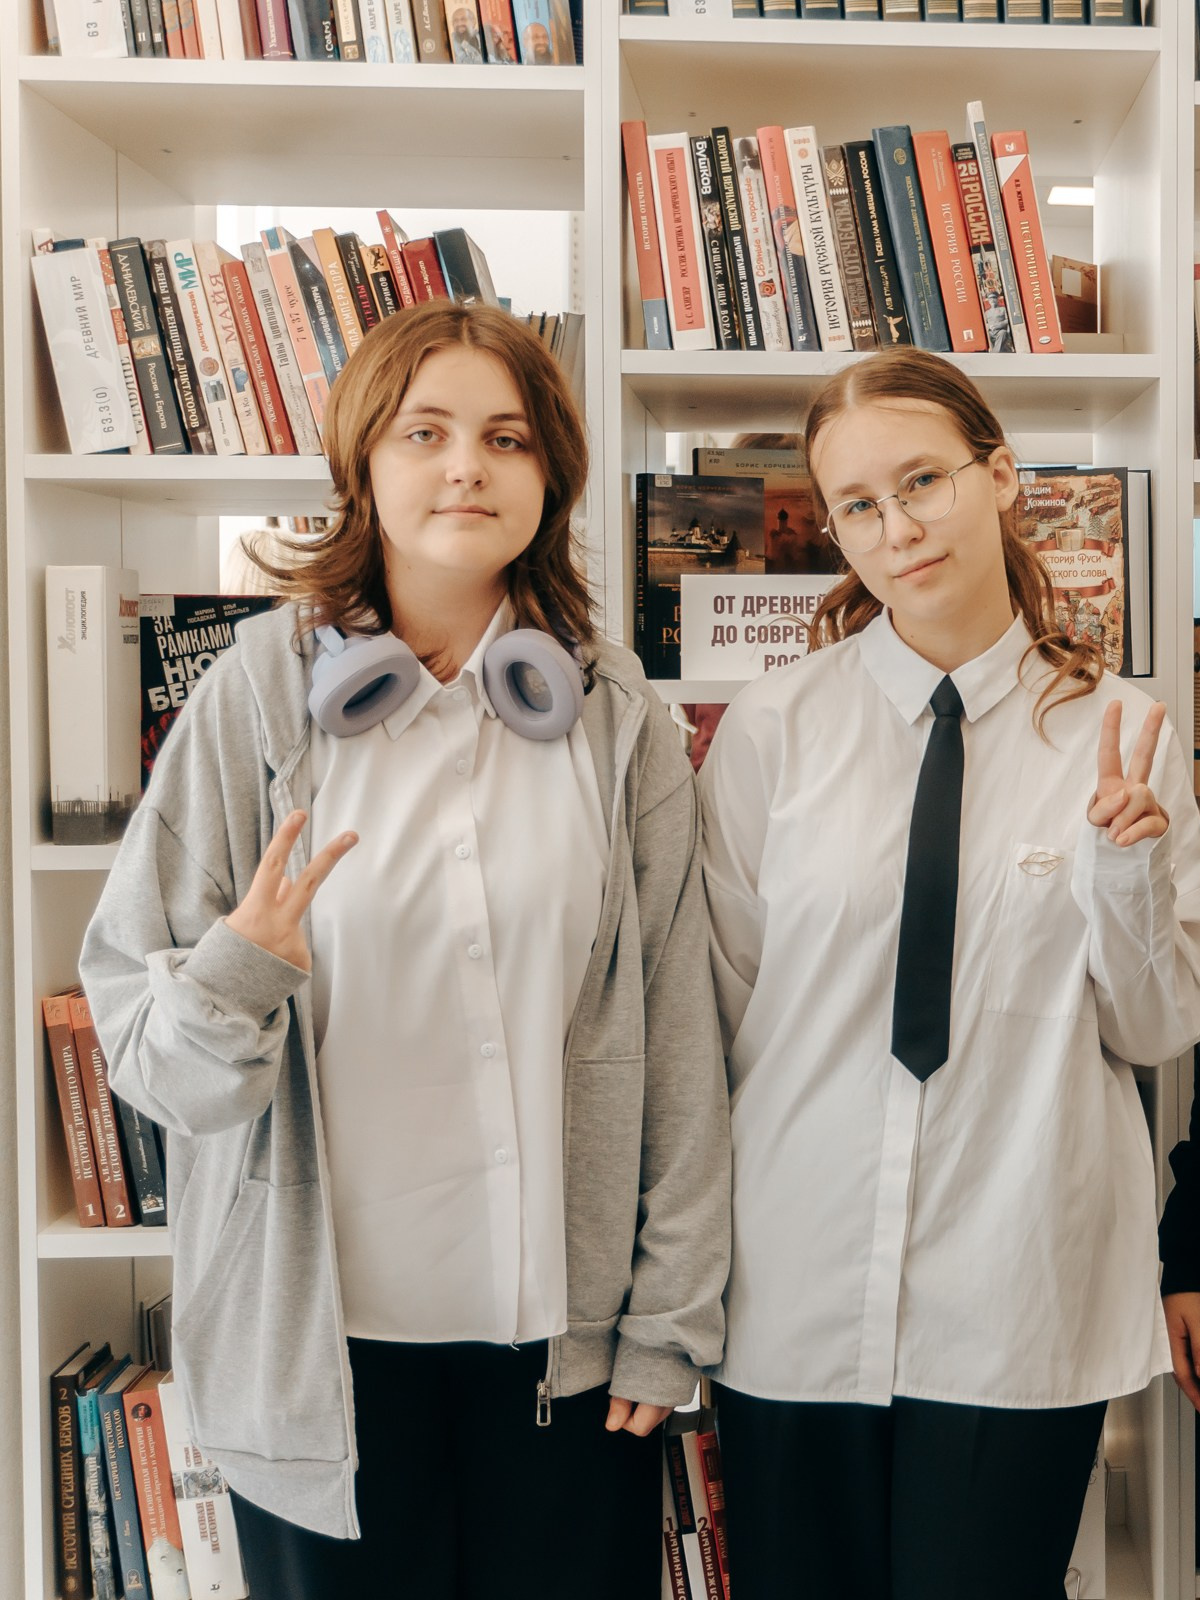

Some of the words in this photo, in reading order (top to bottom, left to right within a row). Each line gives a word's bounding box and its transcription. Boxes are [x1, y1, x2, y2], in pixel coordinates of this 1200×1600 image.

[696, 141, 712, 195] БУШКОВ
[717, 134, 731, 174] ГЕОРГИЙ
[859, 151, 870, 179] РОССИЯ
[957, 161, 978, 176] 26
[636, 172, 647, 220] ОТЕЧЕСТВА
[723, 175, 741, 231] ВЕРНАДСКИЙ
[801, 163, 823, 223] КУЛЬТУРЫ
[864, 181, 877, 219] ЗАВЕЩАНА
[811, 226, 833, 275] РУССКОЙ
[835, 198, 860, 275] ОТЕЧЕСТВА
[941, 202, 959, 254] ИСТОРИЯ
[951, 258, 968, 304] РОССИИ
[173, 252, 199, 290] МИР
[390, 250, 403, 273] ВЕЩЕЙ
[733, 236, 747, 279] НАЧЕРТАНИЕ
[1019, 220, 1039, 278] ИСТОРИЯ
[1030, 280, 1047, 330] РОССИИ
[71, 276, 82, 301] МИР
[117, 254, 143, 332] ДАНИЛЕВСКИЙ
[208, 272, 237, 344] МАЙЯ
[233, 276, 246, 303] ЛЮДЕЙ
[284, 285, 297, 308] чудес
[311, 286, 325, 314] КУЛЬТУРЫ
[328, 262, 353, 325] ИМПЕРАТОРА
[378, 277, 396, 315] СТАРИКОВ
[398, 276, 412, 304] СУДЬБЫ
[717, 283, 727, 303] ИЩИ
[740, 281, 753, 312] РУССКОЙ
[822, 278, 840, 330] ИСТОРИЯ
[80, 305, 99, 359] ДРЕВНИЙ
[241, 306, 256, 341] ВЕЛИКИХ
[258, 288, 281, 338] цивилизаций
[319, 316, 333, 344] МИРОВОЙ
[720, 306, 732, 339] ВОРА!
[745, 313, 757, 346] ИСТОРИИ
[154, 263, 169, 295] ЖЕНЫ
[164, 306, 184, 357] ЖЕНЩИНЫ
[176, 358, 200, 428] ДИКТАТОРОВ
[251, 344, 265, 377] ПИСЬМА
[273, 343, 289, 368] Тайны
[148, 362, 159, 392] Россия
[92, 386, 114, 433] 63.3(0)
[260, 379, 277, 423] ЛЮБОВНЫЕ
[713, 595, 736, 614] ОТ
[152, 616, 175, 635] ЗА
[156, 623, 236, 659] РАМКАМИ
[711, 625, 738, 647] ДО
[62, 1045, 74, 1075] МИРА
[91, 1047, 102, 1077] МИРА
[68, 1076, 87, 1130] ДРЕВНЕГО
[97, 1078, 116, 1130] ДРЕВНЕГО
[77, 1131, 93, 1179] ИСТОРИЯ
[91, 1108, 107, 1167] Немировский
[106, 1132, 122, 1182] ИСТОРИЯ
[86, 1203, 97, 1216] 1
[114, 1204, 126, 1218] 2
[59, 1405, 73, 1447] ВЕКОВ
[103, 1411, 115, 1459] КРЕСТОВЫХ
[113, 1409, 125, 1449] ПОХОДОВ
[146, 1426, 156, 1459] Америки
[136, 1427, 148, 1465] ИСТОРИЯ
[60, 1452, 74, 1508] СРЕДНИХ
[110, 1460, 121, 1500] ИСТОРИЯ
[62, 1513, 77, 1569] ИСТОРИЯ
[196, 1502, 208, 1542] НОВАЯ
[205, 1500, 220, 1554] ИСТОРИЯ
[666, 1516, 673, 1531] 1
[696, 1516, 708, 1530] 2
